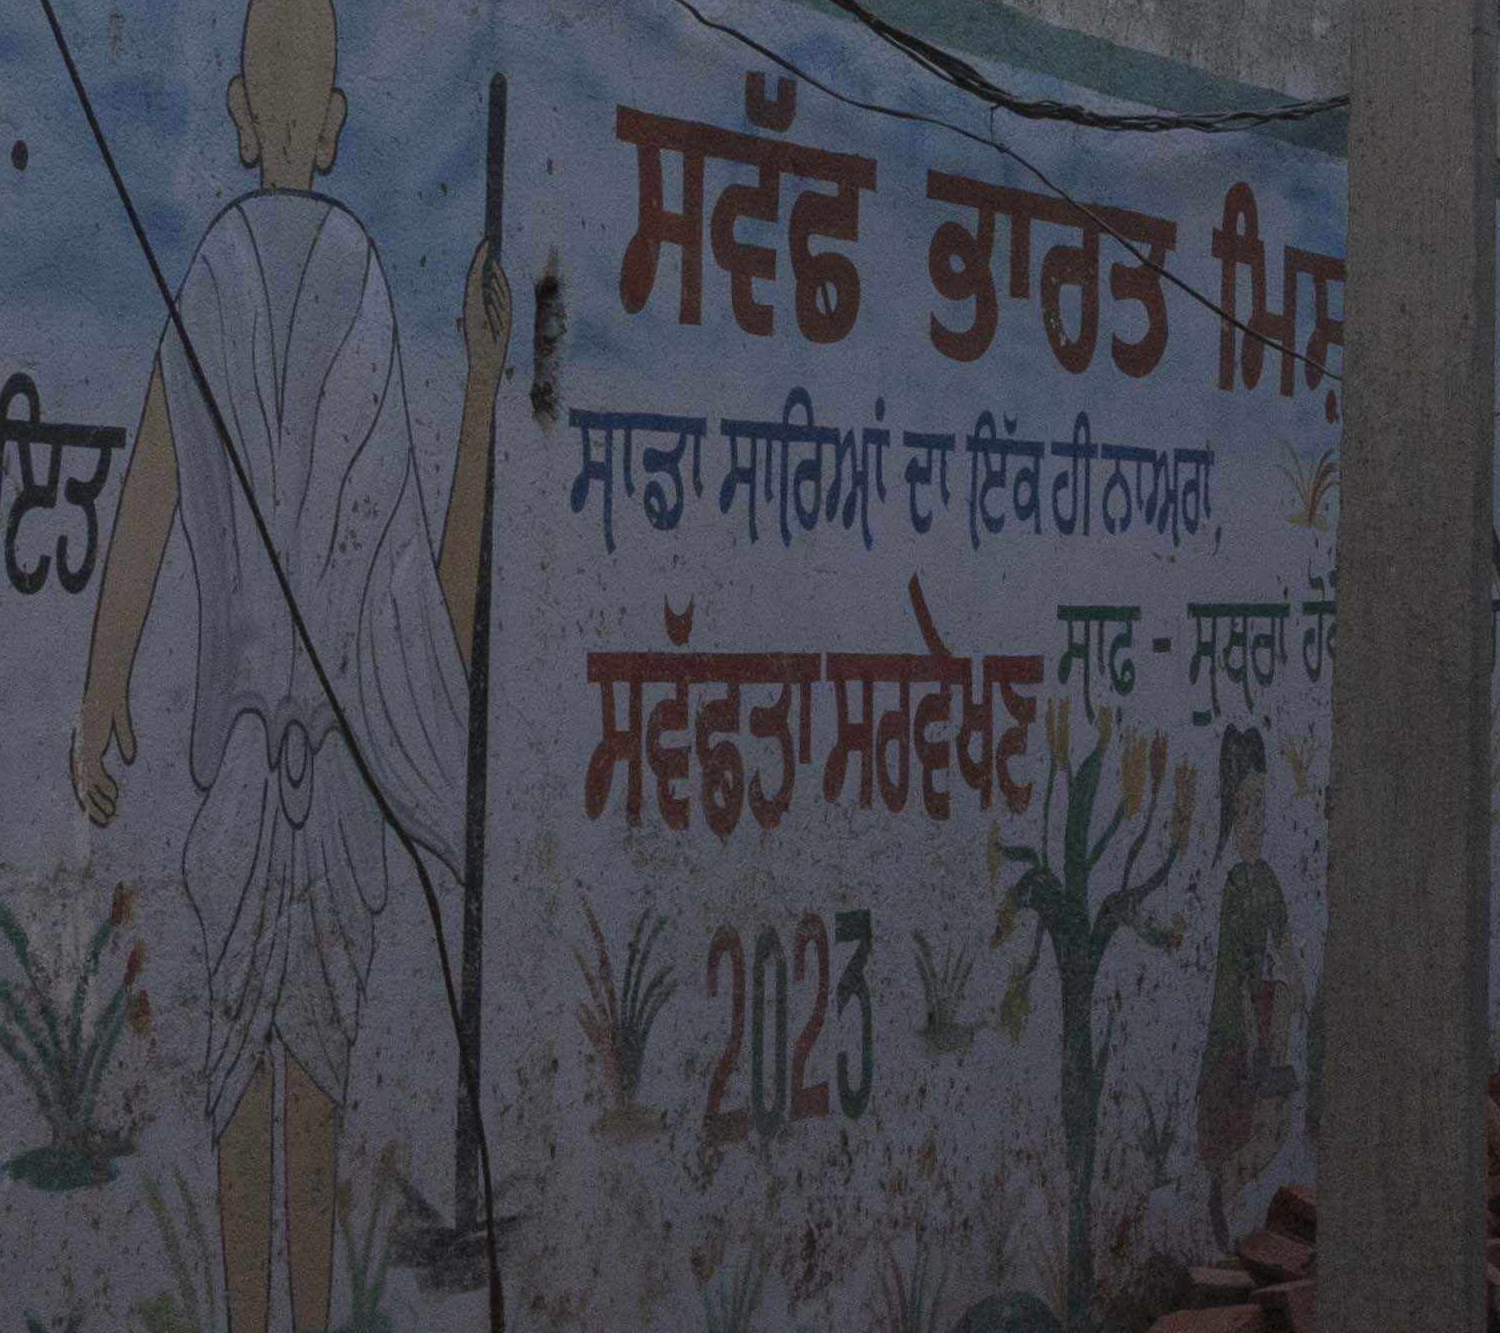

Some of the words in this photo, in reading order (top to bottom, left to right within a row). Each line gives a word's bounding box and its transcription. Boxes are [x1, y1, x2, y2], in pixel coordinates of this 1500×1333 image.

[616, 70, 877, 344] ਸਵੱਛ
[926, 169, 1178, 379] ਭਾਰਤ
[902, 430, 956, 534] ਦਾ
[1051, 410, 1098, 536] ਹੀ
[585, 592, 821, 837] ਸਵੱਛਤਾ
[822, 572, 1044, 821] ਸਰਵੇਖਣ
[706, 909, 874, 1134] 2023
